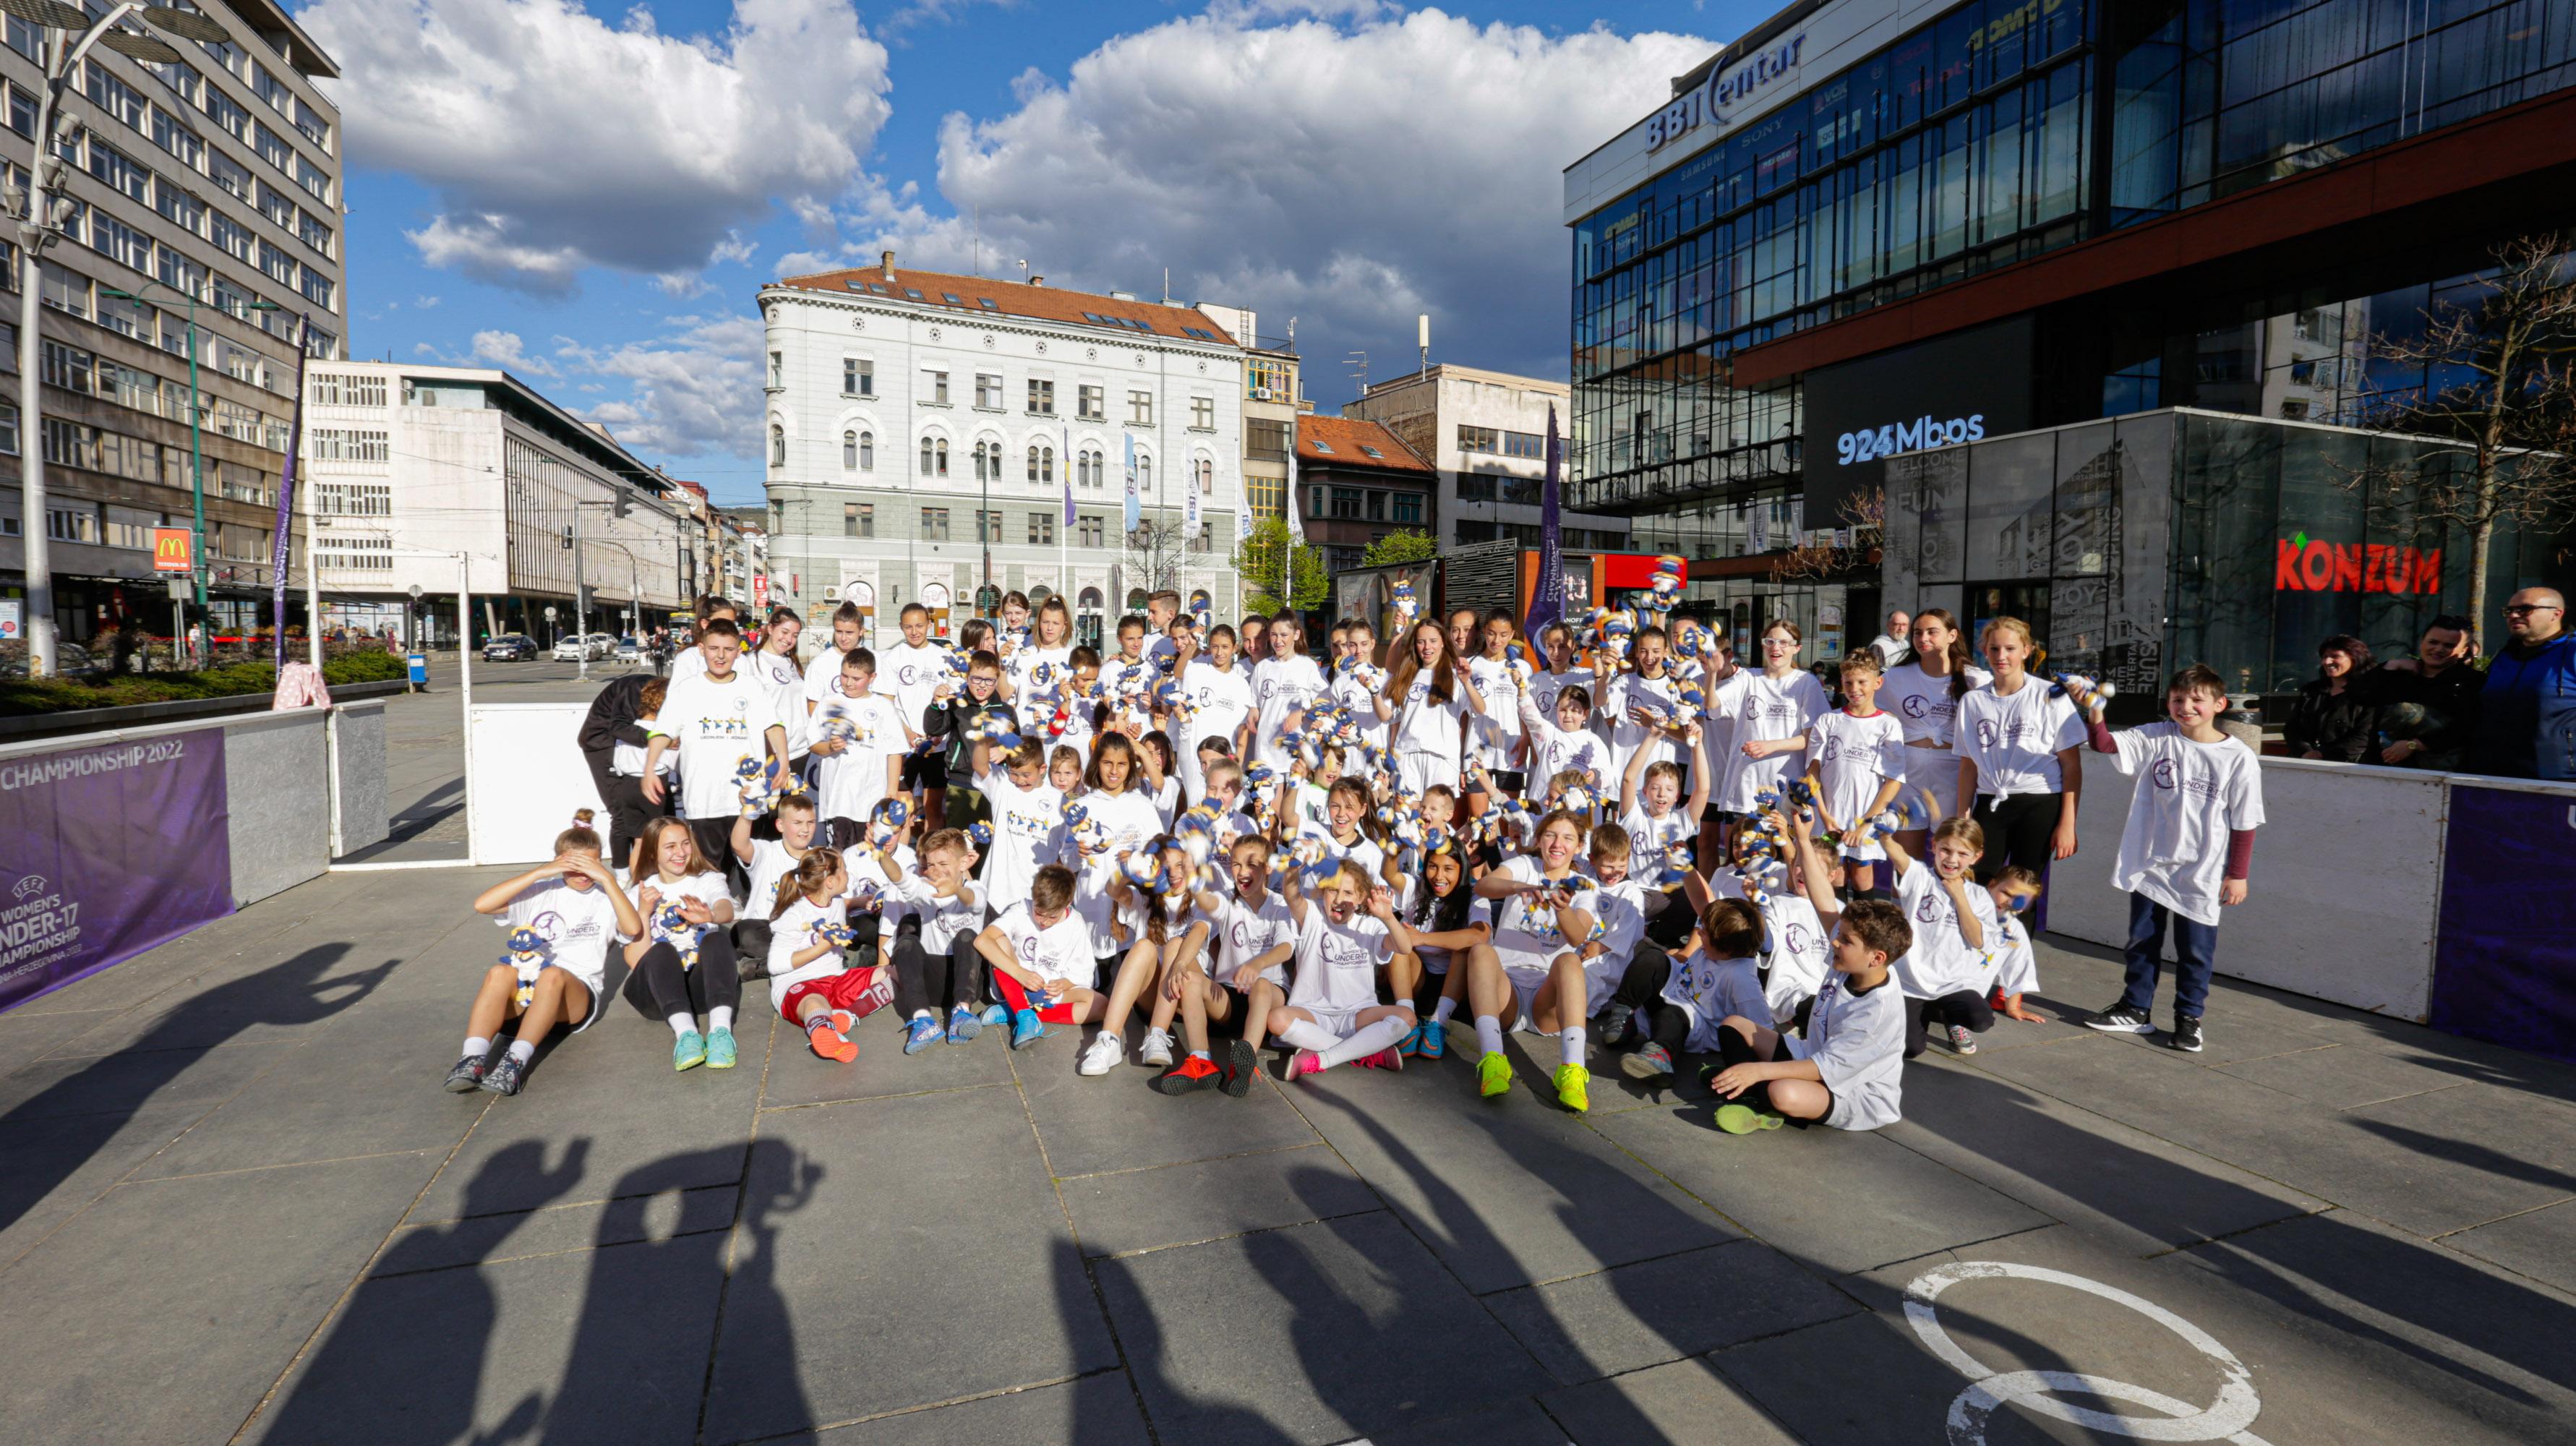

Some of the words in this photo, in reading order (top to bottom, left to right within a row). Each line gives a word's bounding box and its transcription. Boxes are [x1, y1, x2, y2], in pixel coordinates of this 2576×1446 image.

[1646, 92, 1700, 153] BBI
[1703, 34, 1805, 126] Centar
[1742, 116, 1784, 148] SONY
[1680, 148, 1726, 181] SAMSUNG
[2277, 537, 2441, 594] KONZUM
[1, 745, 145, 790] CHAMPIONSHIP
[147, 739, 184, 763] 2022
[14, 878, 44, 898] UEFA
[1, 894, 61, 924] WOMEN'S
[0, 902, 79, 951] NDER-17
[1335, 952, 1368, 962] UNDER-17
